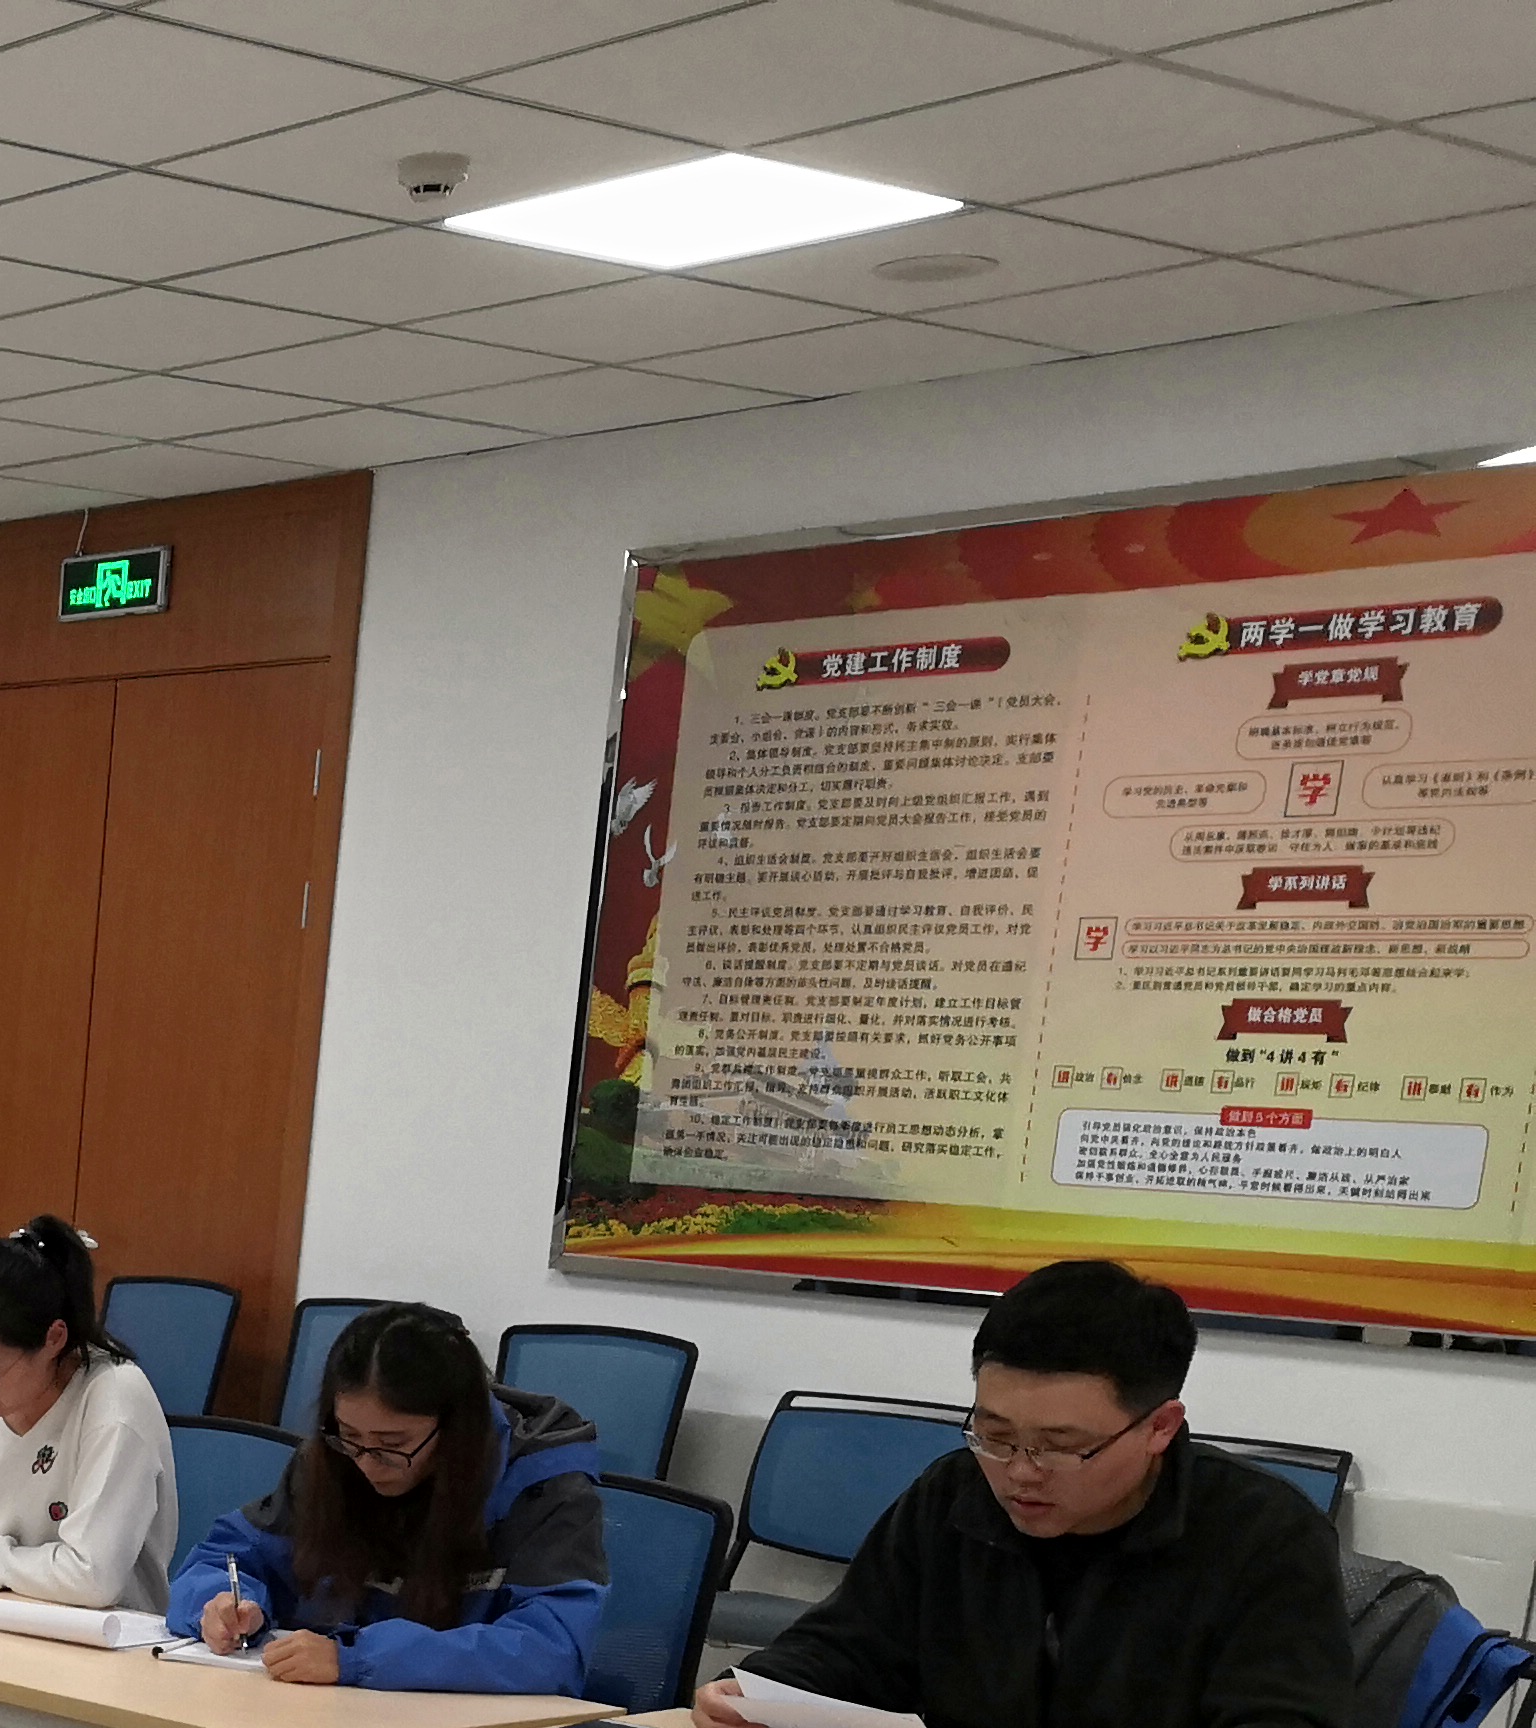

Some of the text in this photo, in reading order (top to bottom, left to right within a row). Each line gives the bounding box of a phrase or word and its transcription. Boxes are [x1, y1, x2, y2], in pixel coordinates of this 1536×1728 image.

[127, 578, 152, 600] EXIT
[1240, 602, 1482, 648] 两学一做学习教育
[821, 643, 962, 679] 党建工作制度
[1297, 771, 1332, 808] 学
[1267, 873, 1348, 893] 学系列讲话
[1083, 925, 1109, 952] 学
[1246, 1005, 1323, 1024] 做合格党员
